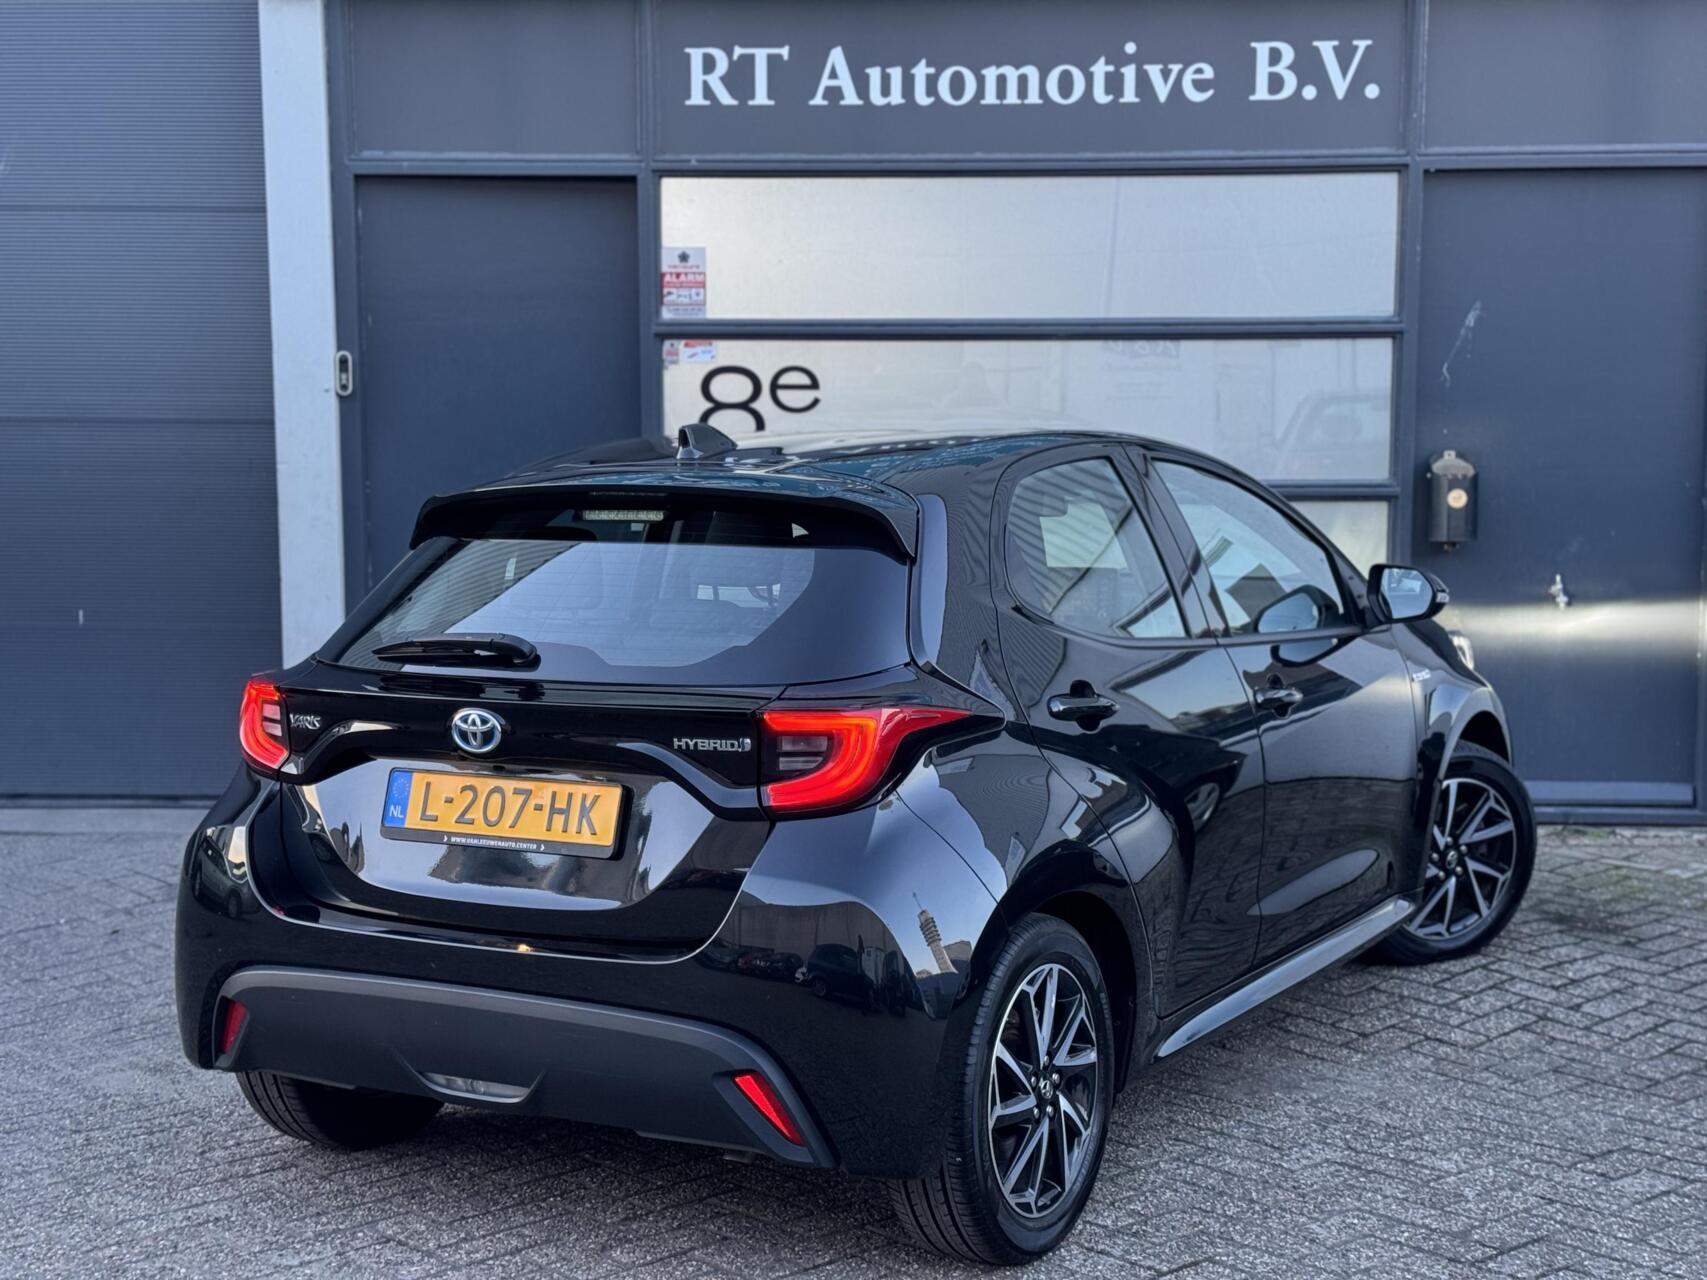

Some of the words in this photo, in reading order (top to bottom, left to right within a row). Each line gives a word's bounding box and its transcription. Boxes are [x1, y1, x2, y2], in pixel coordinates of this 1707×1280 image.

[684, 45, 789, 106] RT
[808, 41, 1215, 107] Automotive
[1248, 39, 1380, 101] B.V.
[664, 272, 705, 283] ALARM
[673, 738, 740, 752] HYBRID
[389, 804, 404, 818] NL
[419, 781, 602, 836] L-207-HK
